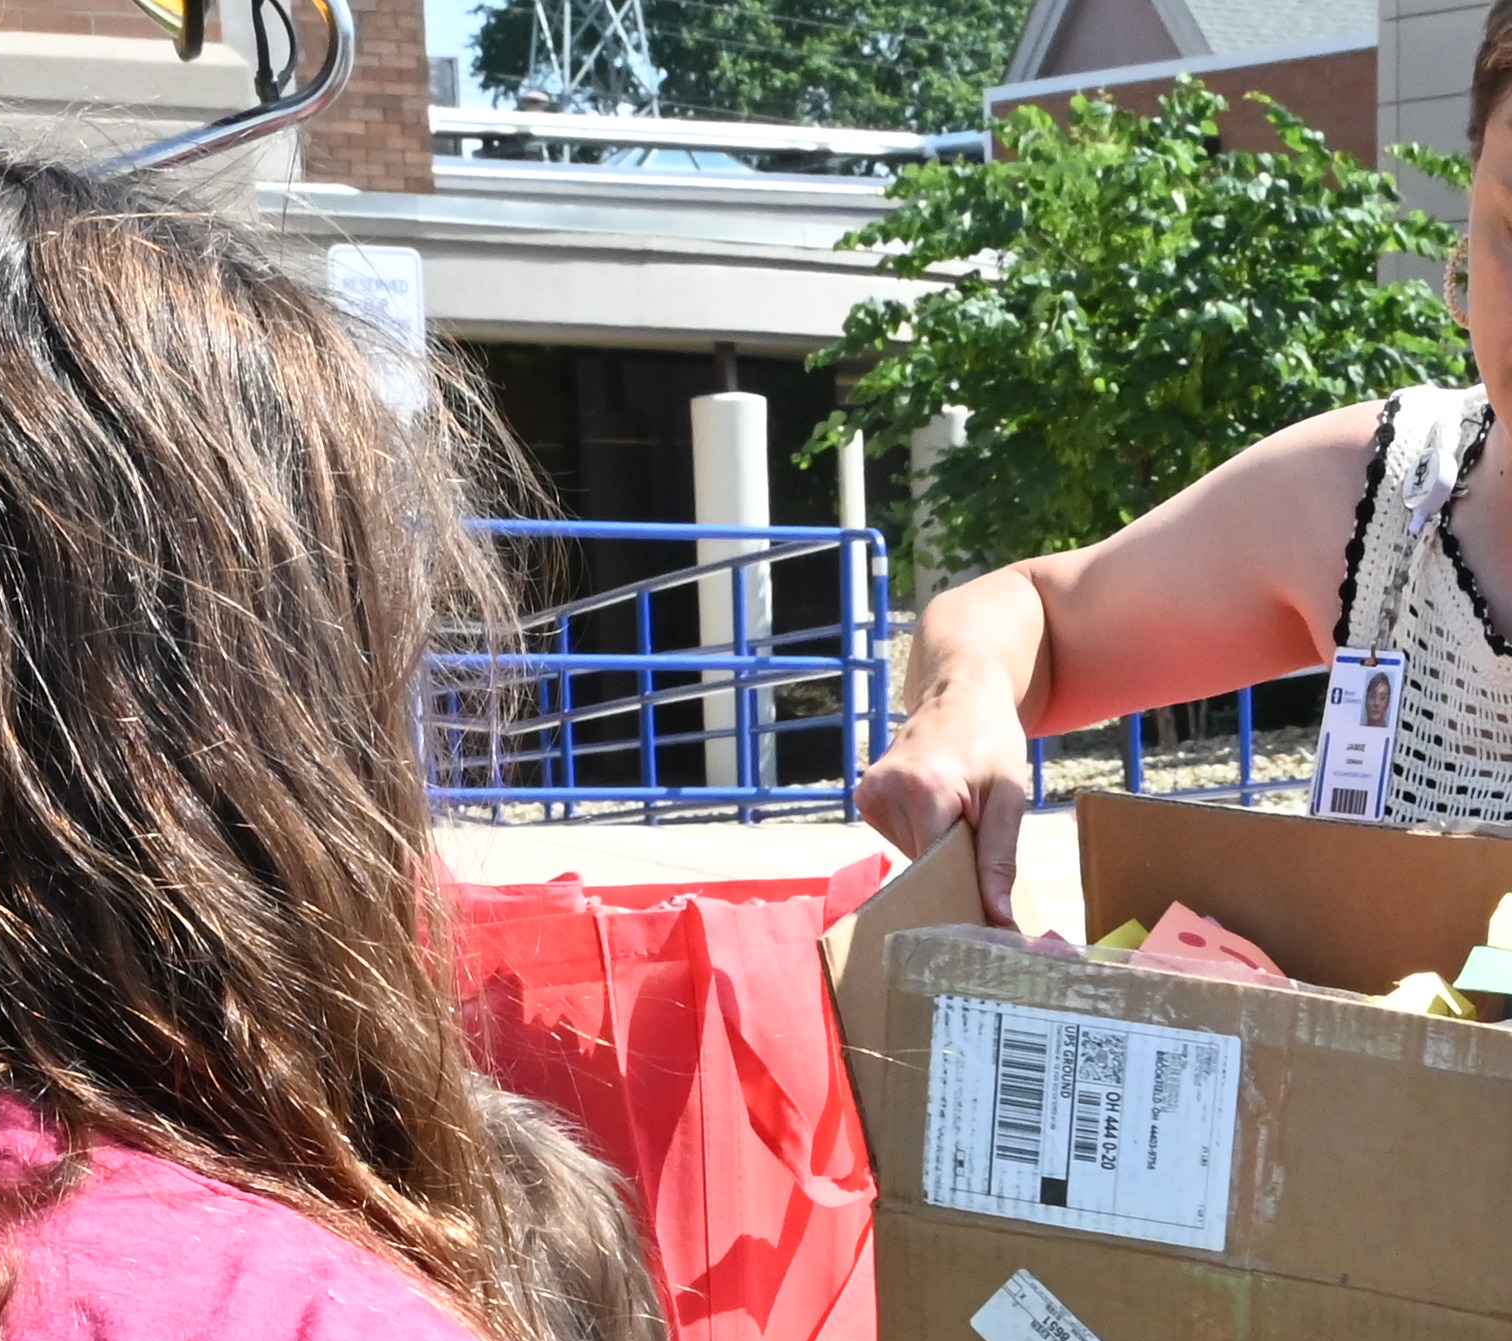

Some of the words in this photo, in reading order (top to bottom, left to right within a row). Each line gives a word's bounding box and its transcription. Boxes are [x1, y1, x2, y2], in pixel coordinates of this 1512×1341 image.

[1064, 1026, 1076, 1048] UPS
[1061, 1051, 1075, 1099] GROUND
[1107, 1091, 1121, 1112] OH
[1103, 1115, 1119, 1139] 444
[1101, 1142, 1117, 1170] 0-20
